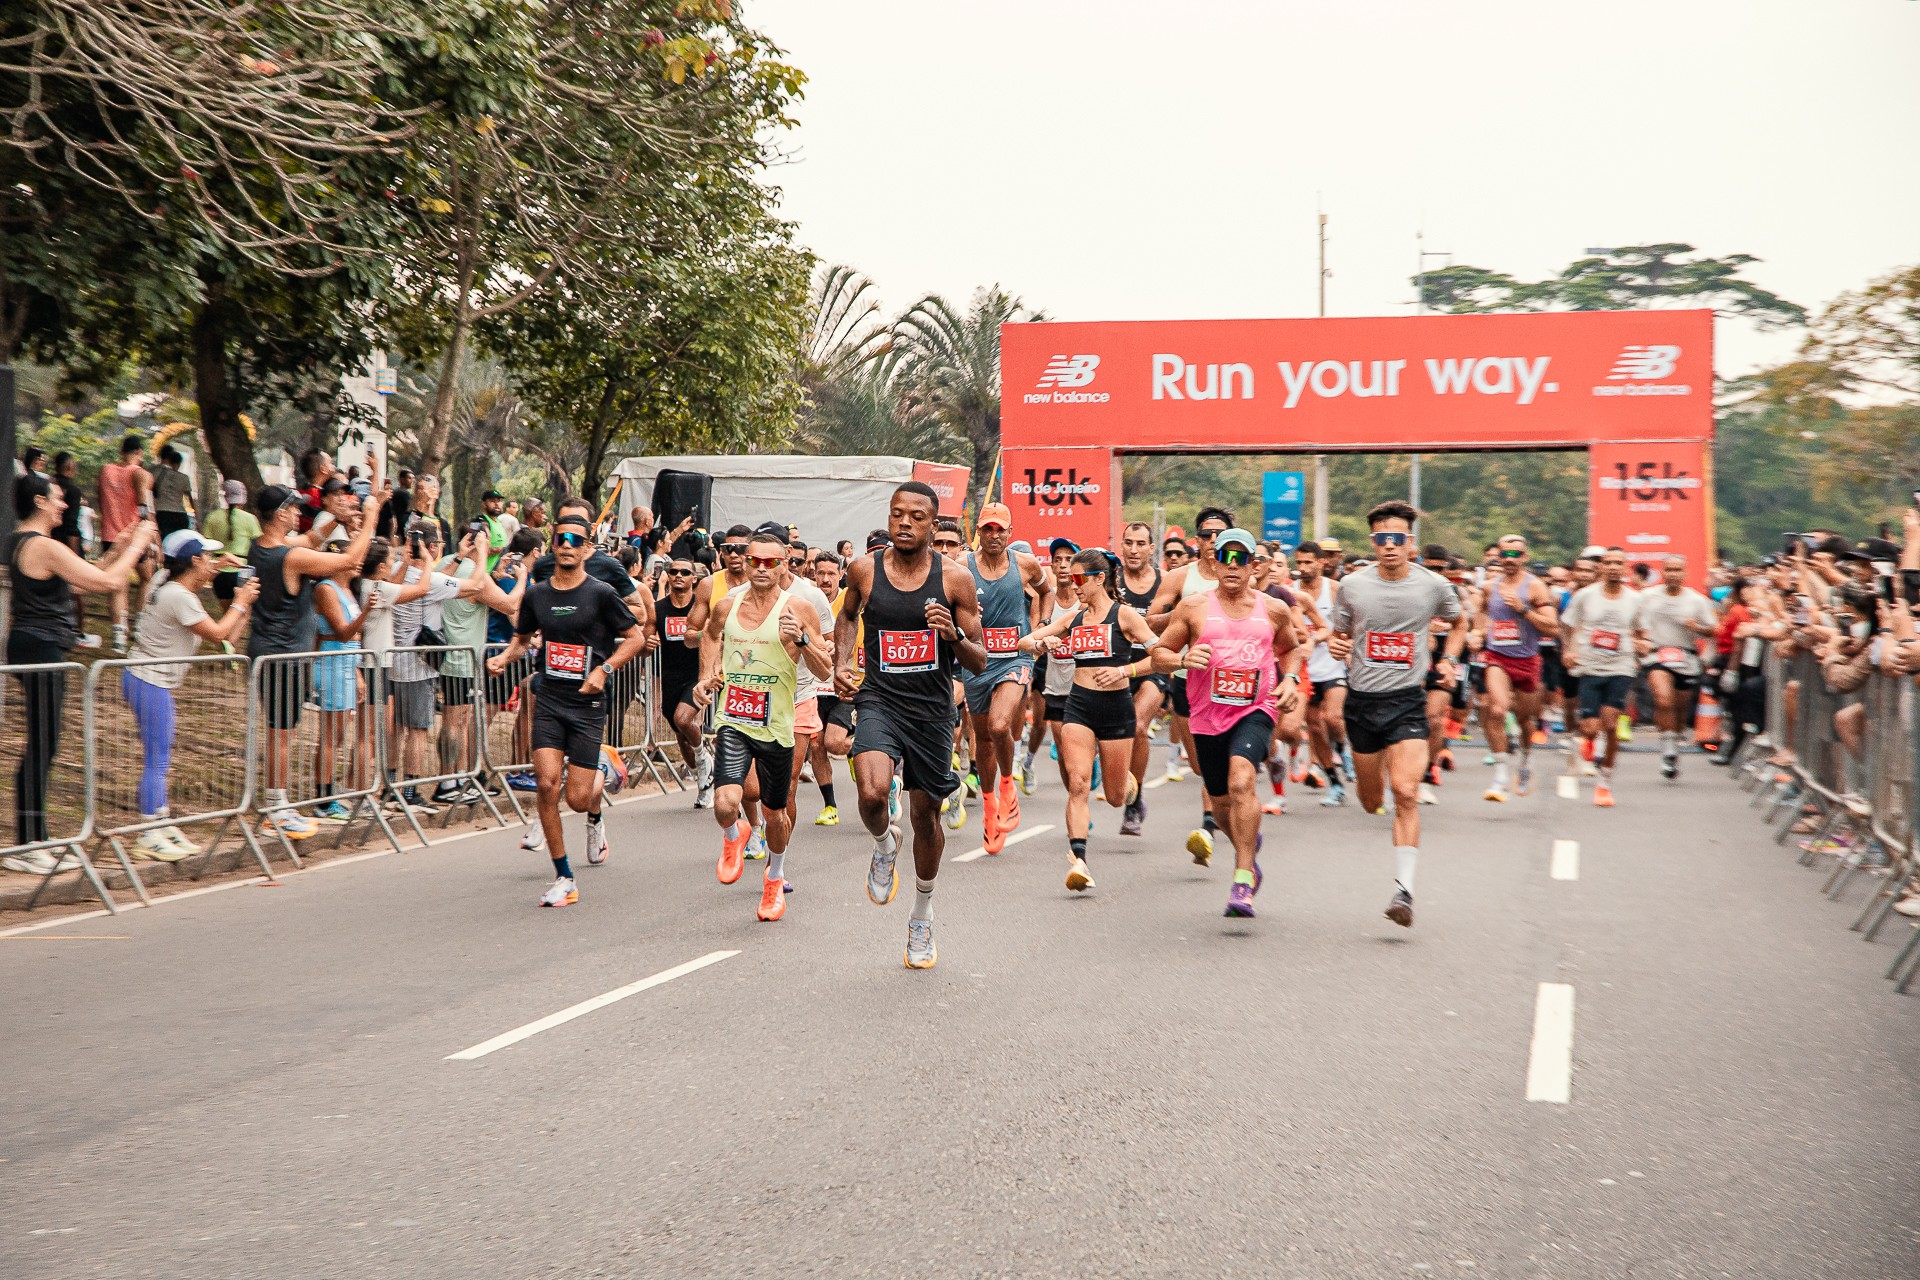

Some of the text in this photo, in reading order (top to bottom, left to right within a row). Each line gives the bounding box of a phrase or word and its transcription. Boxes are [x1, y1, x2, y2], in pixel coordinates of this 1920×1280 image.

[1152, 353, 1559, 408] Run your way.
[1024, 391, 1111, 404] new balance
[1011, 481, 1101, 494] Rio de Janeiro
[1024, 468, 1093, 506] 15k
[1615, 462, 1690, 500] 15k
[987, 637, 1016, 649] 5152
[1075, 635, 1104, 648] 3165
[887, 644, 928, 660] 5077
[1371, 644, 1410, 658] 3399
[550, 653, 583, 669] 3925
[1217, 679, 1254, 694] 2241
[728, 698, 763, 715] 2684
